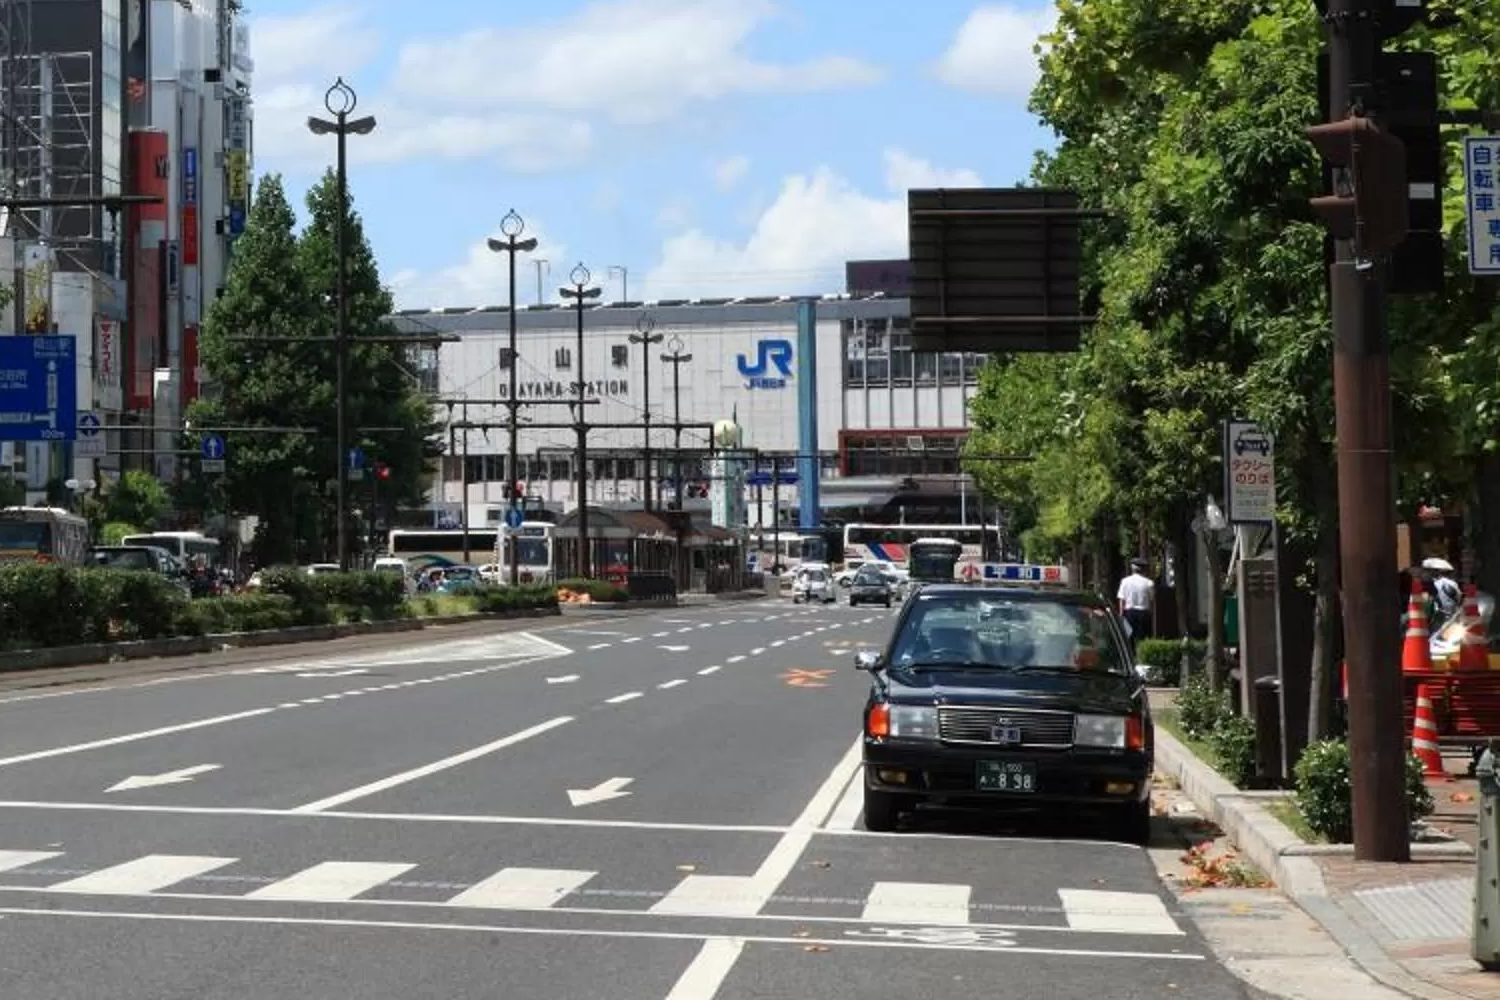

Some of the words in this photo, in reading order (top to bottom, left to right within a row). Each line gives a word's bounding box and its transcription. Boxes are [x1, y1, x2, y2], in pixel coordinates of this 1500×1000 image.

[1474, 144, 1494, 212] 自転車
[737, 340, 793, 377] JR
[499, 381, 563, 398] OAYAMA
[1232, 459, 1270, 471] タクシー
